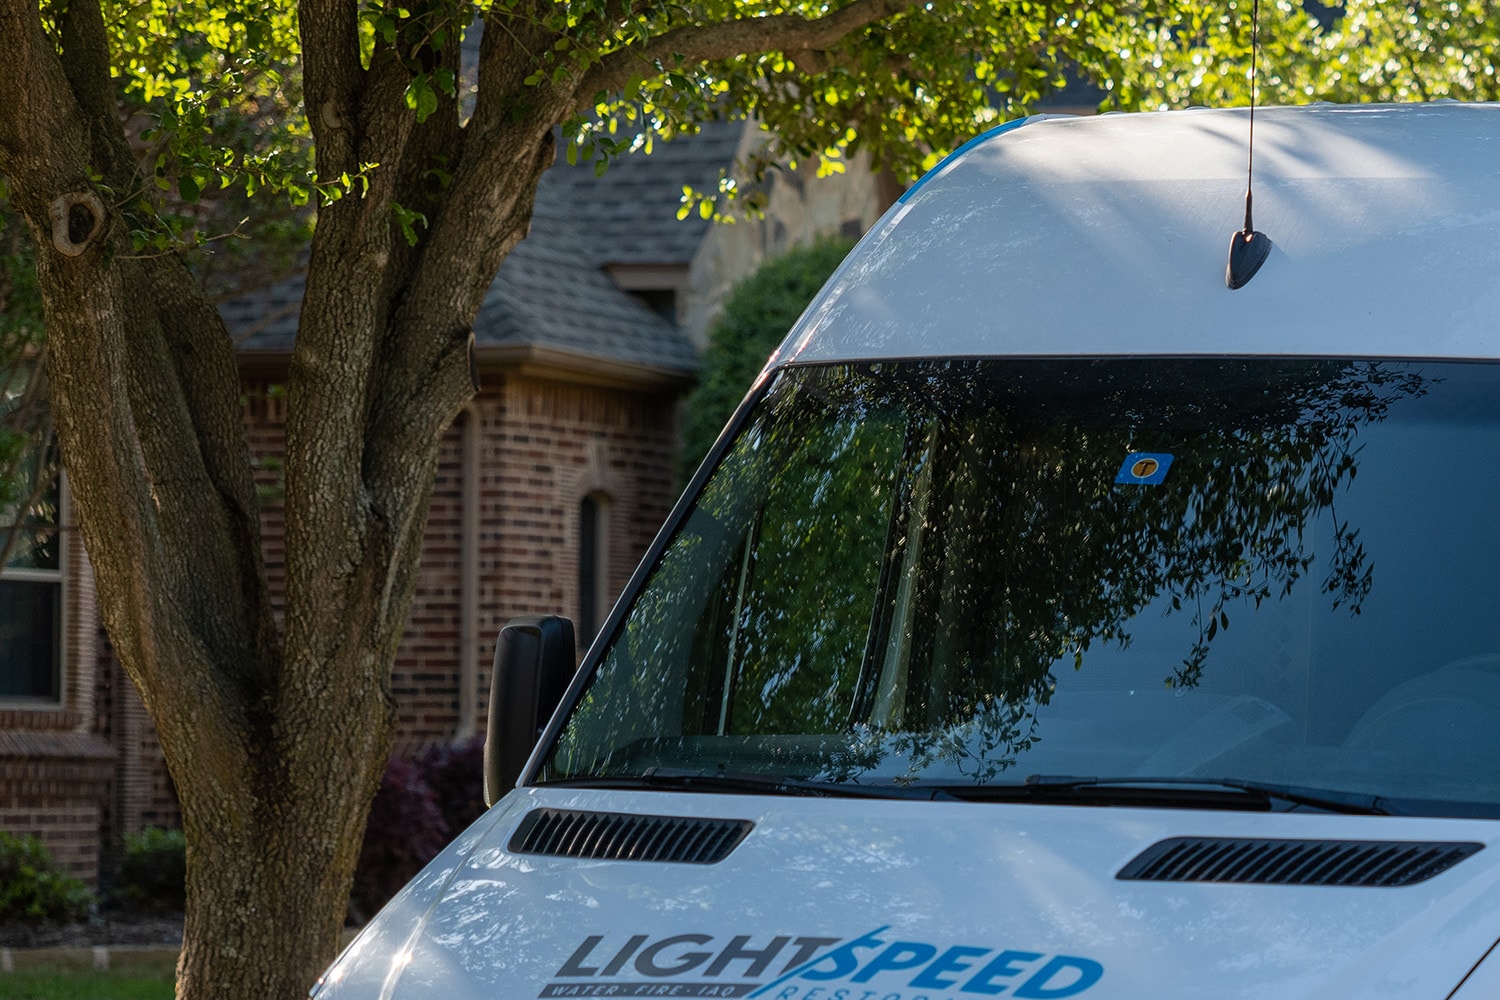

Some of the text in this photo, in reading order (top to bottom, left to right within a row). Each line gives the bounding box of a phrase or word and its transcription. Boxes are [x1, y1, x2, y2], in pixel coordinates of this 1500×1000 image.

[551, 984, 736, 998] WATER FIRE IAQ
